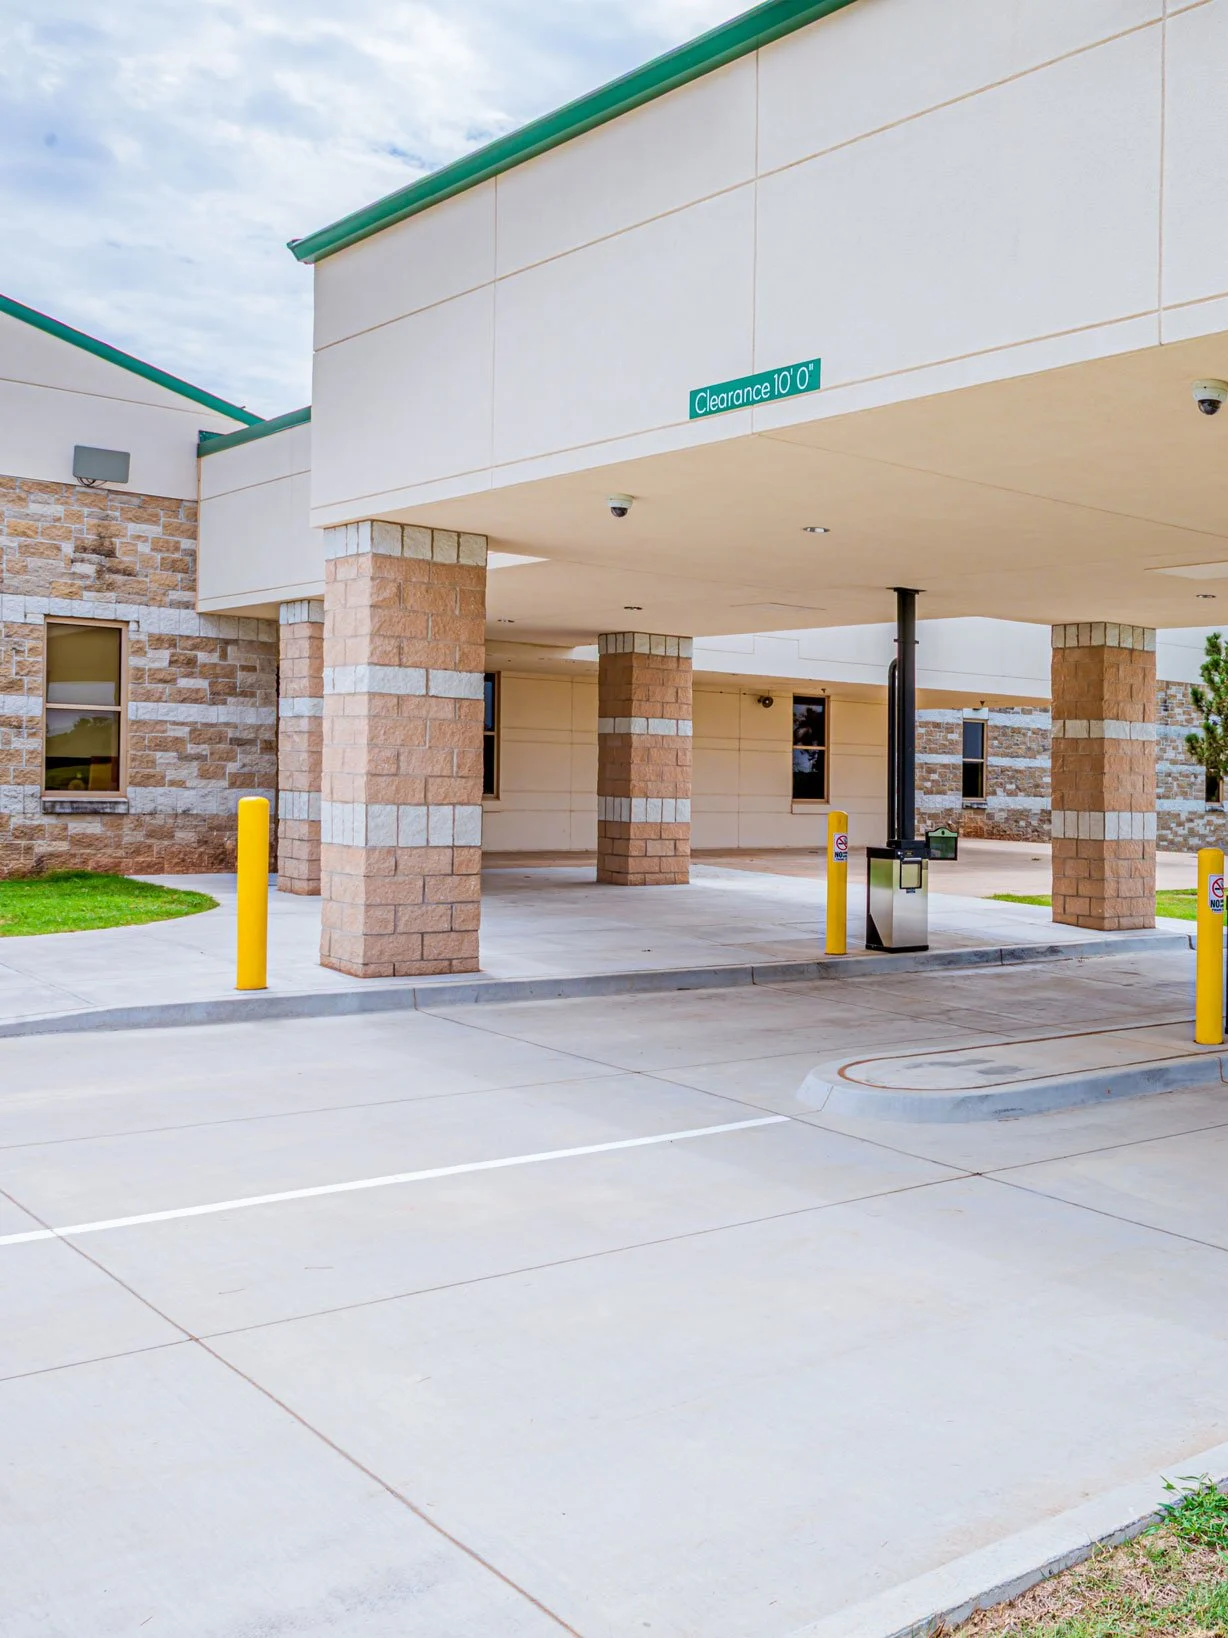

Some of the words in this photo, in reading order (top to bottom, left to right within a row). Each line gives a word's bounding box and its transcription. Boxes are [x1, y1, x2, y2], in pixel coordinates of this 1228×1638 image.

[695, 382, 771, 414] Clearance
[774, 368, 793, 395] 10'
[1210, 899, 1220, 908] NO
